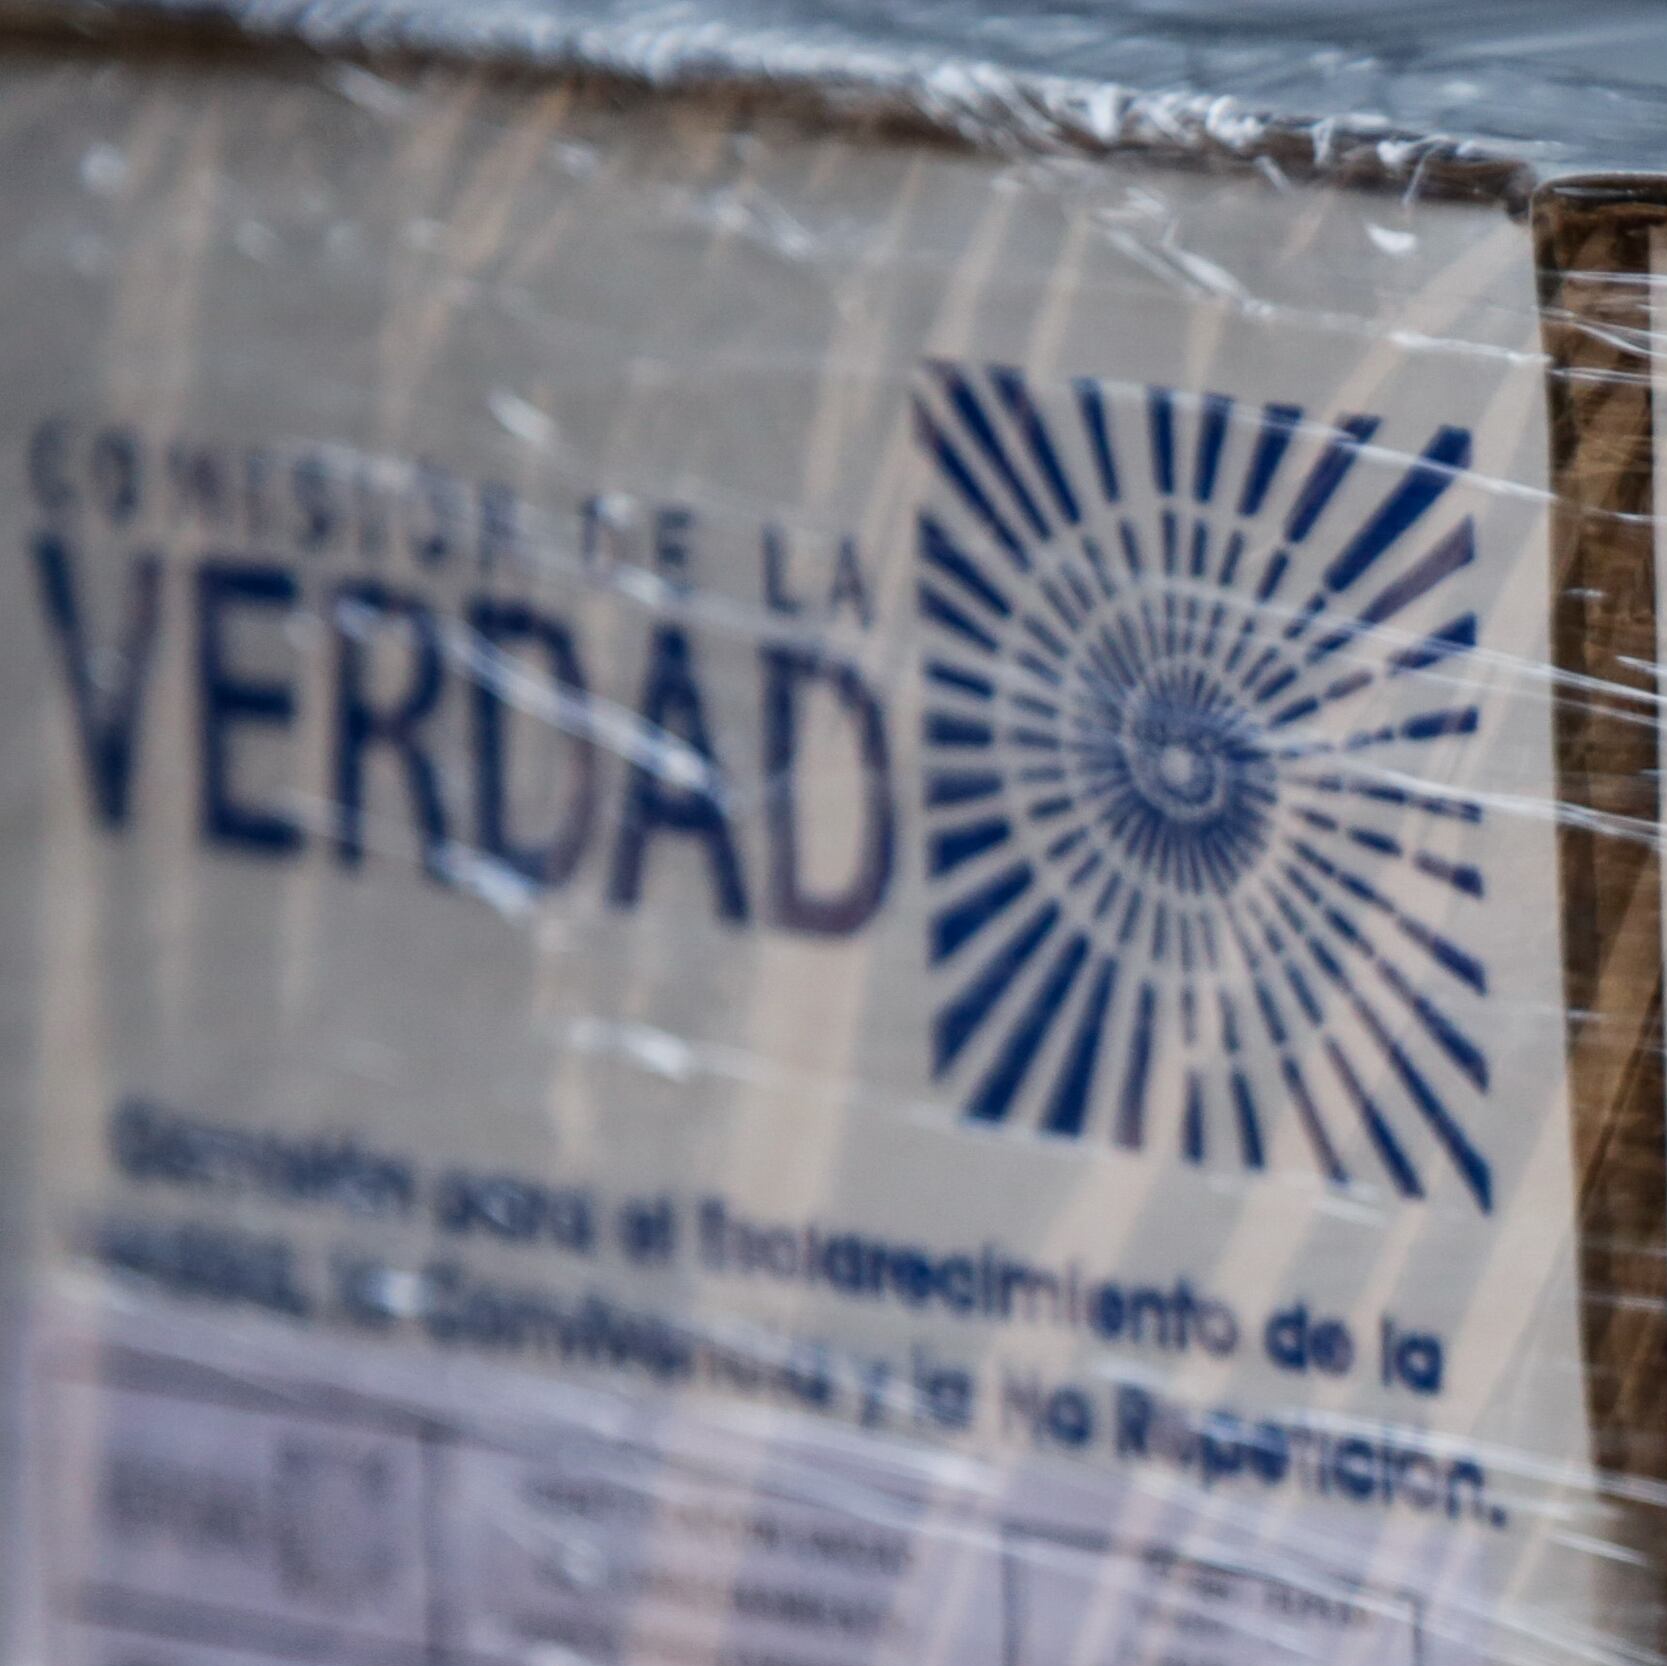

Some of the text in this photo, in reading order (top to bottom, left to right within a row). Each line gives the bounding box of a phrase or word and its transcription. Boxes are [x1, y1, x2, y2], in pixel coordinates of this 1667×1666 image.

[762, 520, 878, 630] LA
[33, 530, 900, 942] VERDAD
[908, 1350, 974, 1436] la
[1264, 1288, 1355, 1370] de
[1378, 1312, 1446, 1395] la
